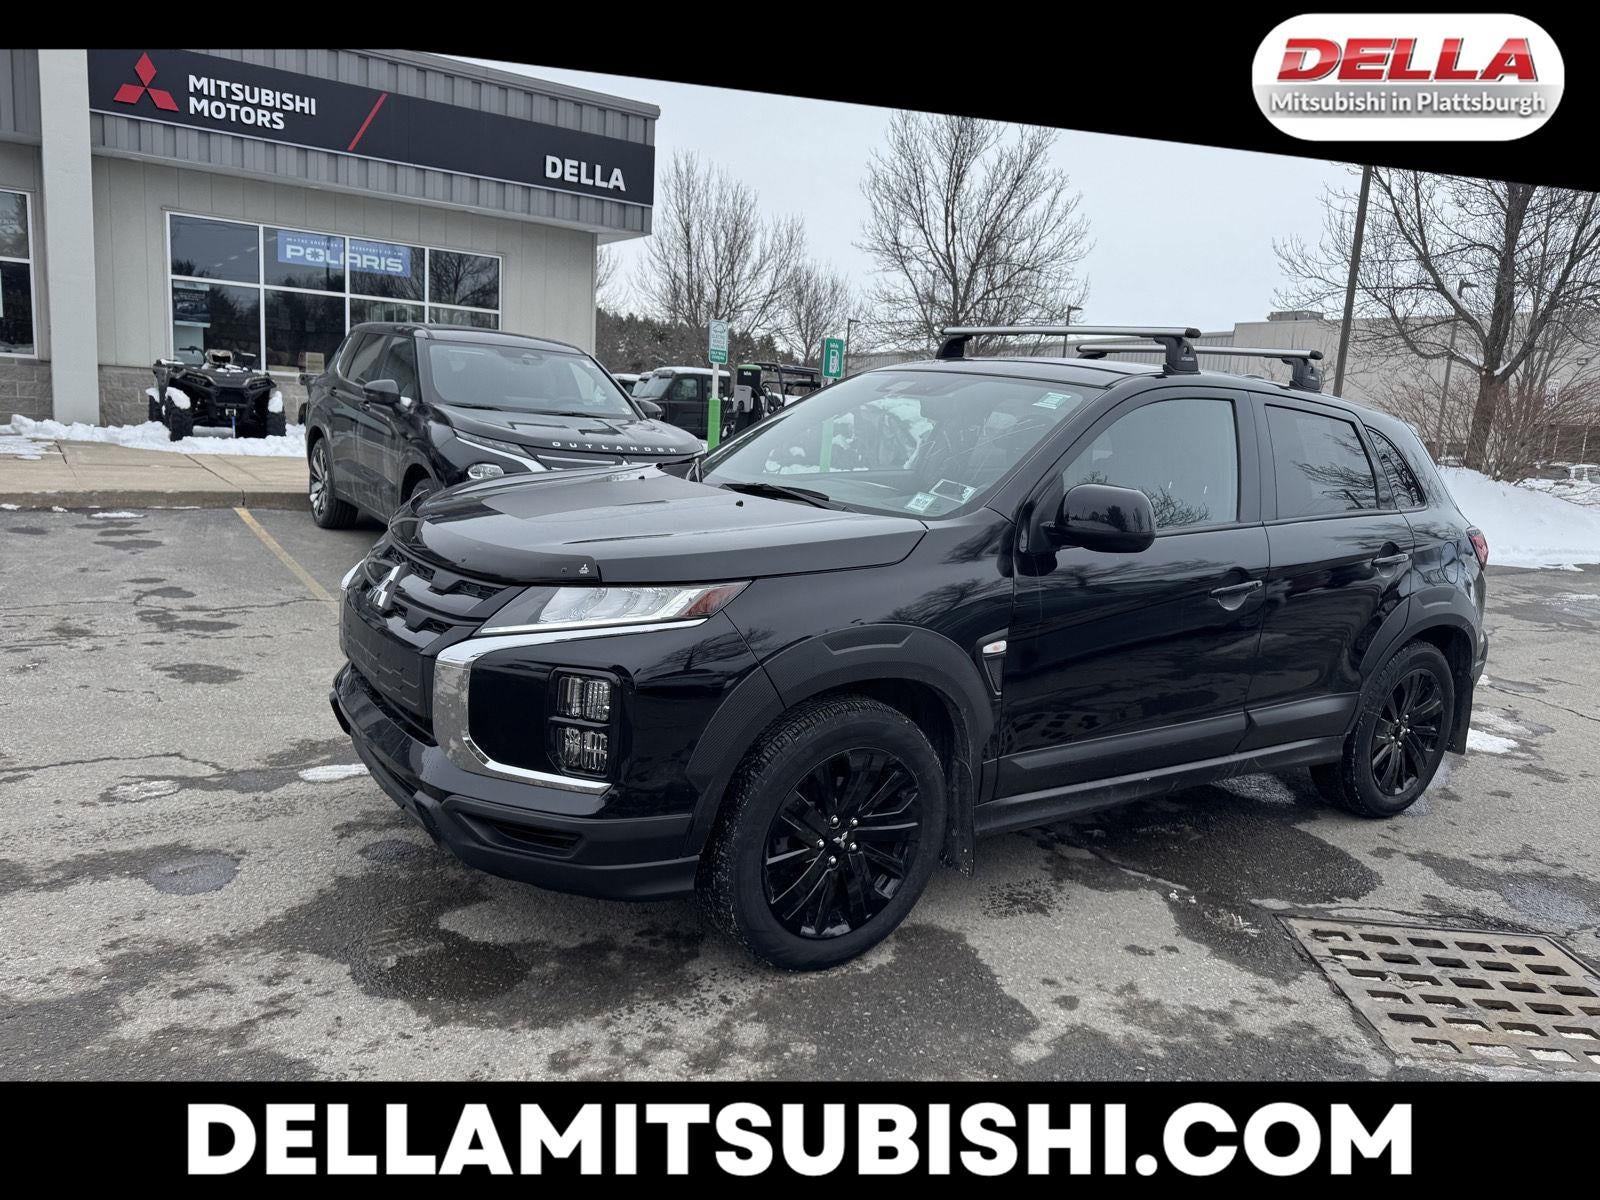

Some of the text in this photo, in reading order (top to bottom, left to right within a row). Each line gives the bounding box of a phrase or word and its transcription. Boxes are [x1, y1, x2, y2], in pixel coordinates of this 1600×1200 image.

[188, 74, 317, 116] MITSUBISHI
[189, 96, 285, 130] MOTORS
[545, 154, 626, 192] DELLA
[286, 244, 403, 272] POLARIS
[552, 441, 677, 453] OUTLANDER
